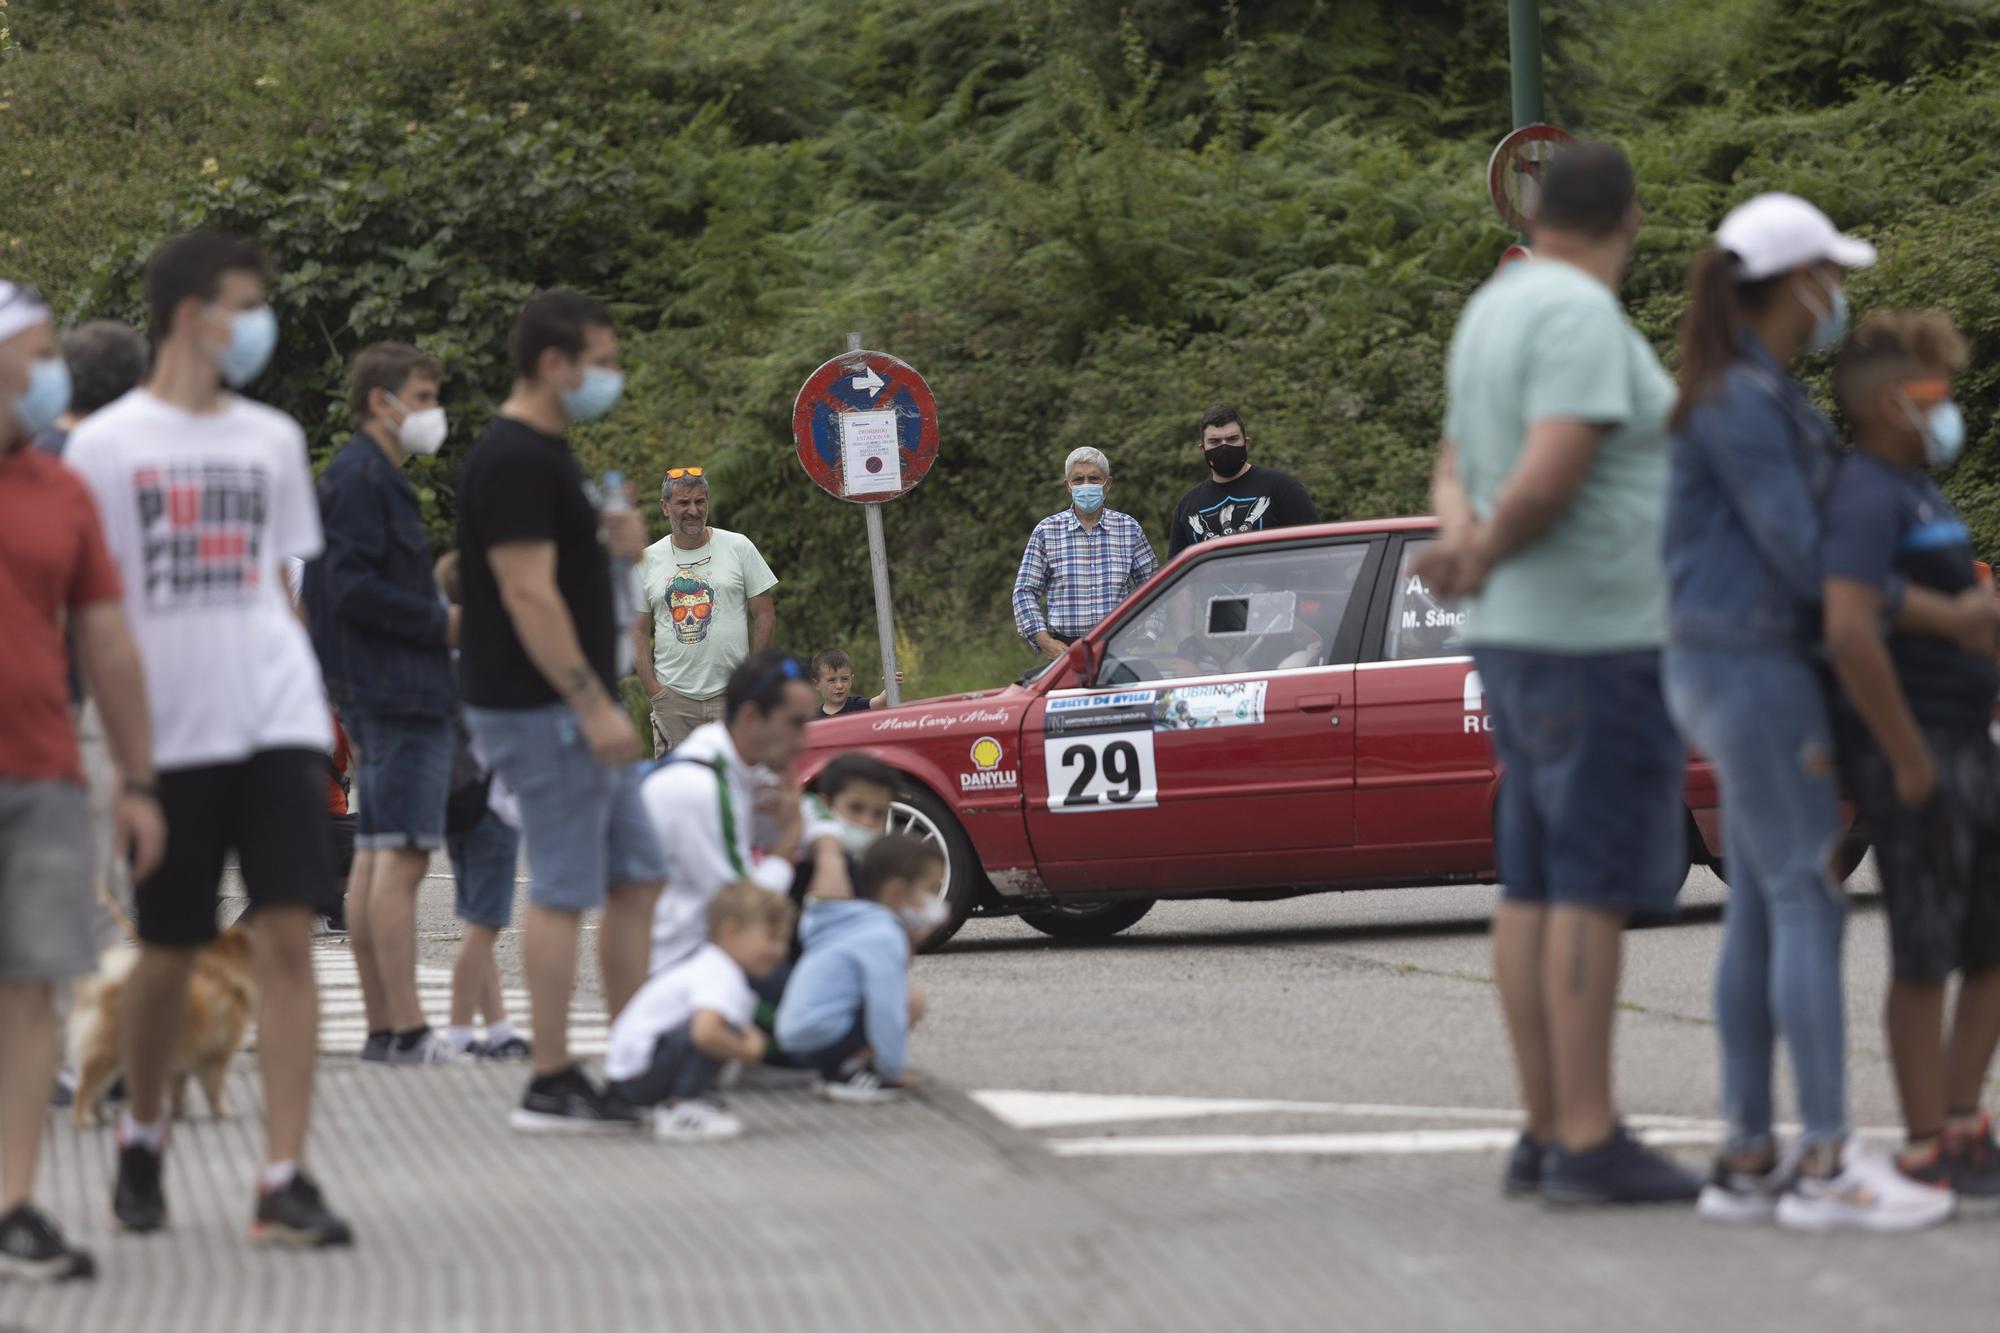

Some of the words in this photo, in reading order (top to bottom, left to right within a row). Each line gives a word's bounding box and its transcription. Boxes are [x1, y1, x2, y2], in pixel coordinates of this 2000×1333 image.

[1406, 574, 1430, 595] A.
[1402, 610, 1420, 628] M.
[1425, 609, 1471, 627] Sánc
[960, 770, 1017, 785] DANYLU
[1062, 740, 1141, 806] 29
